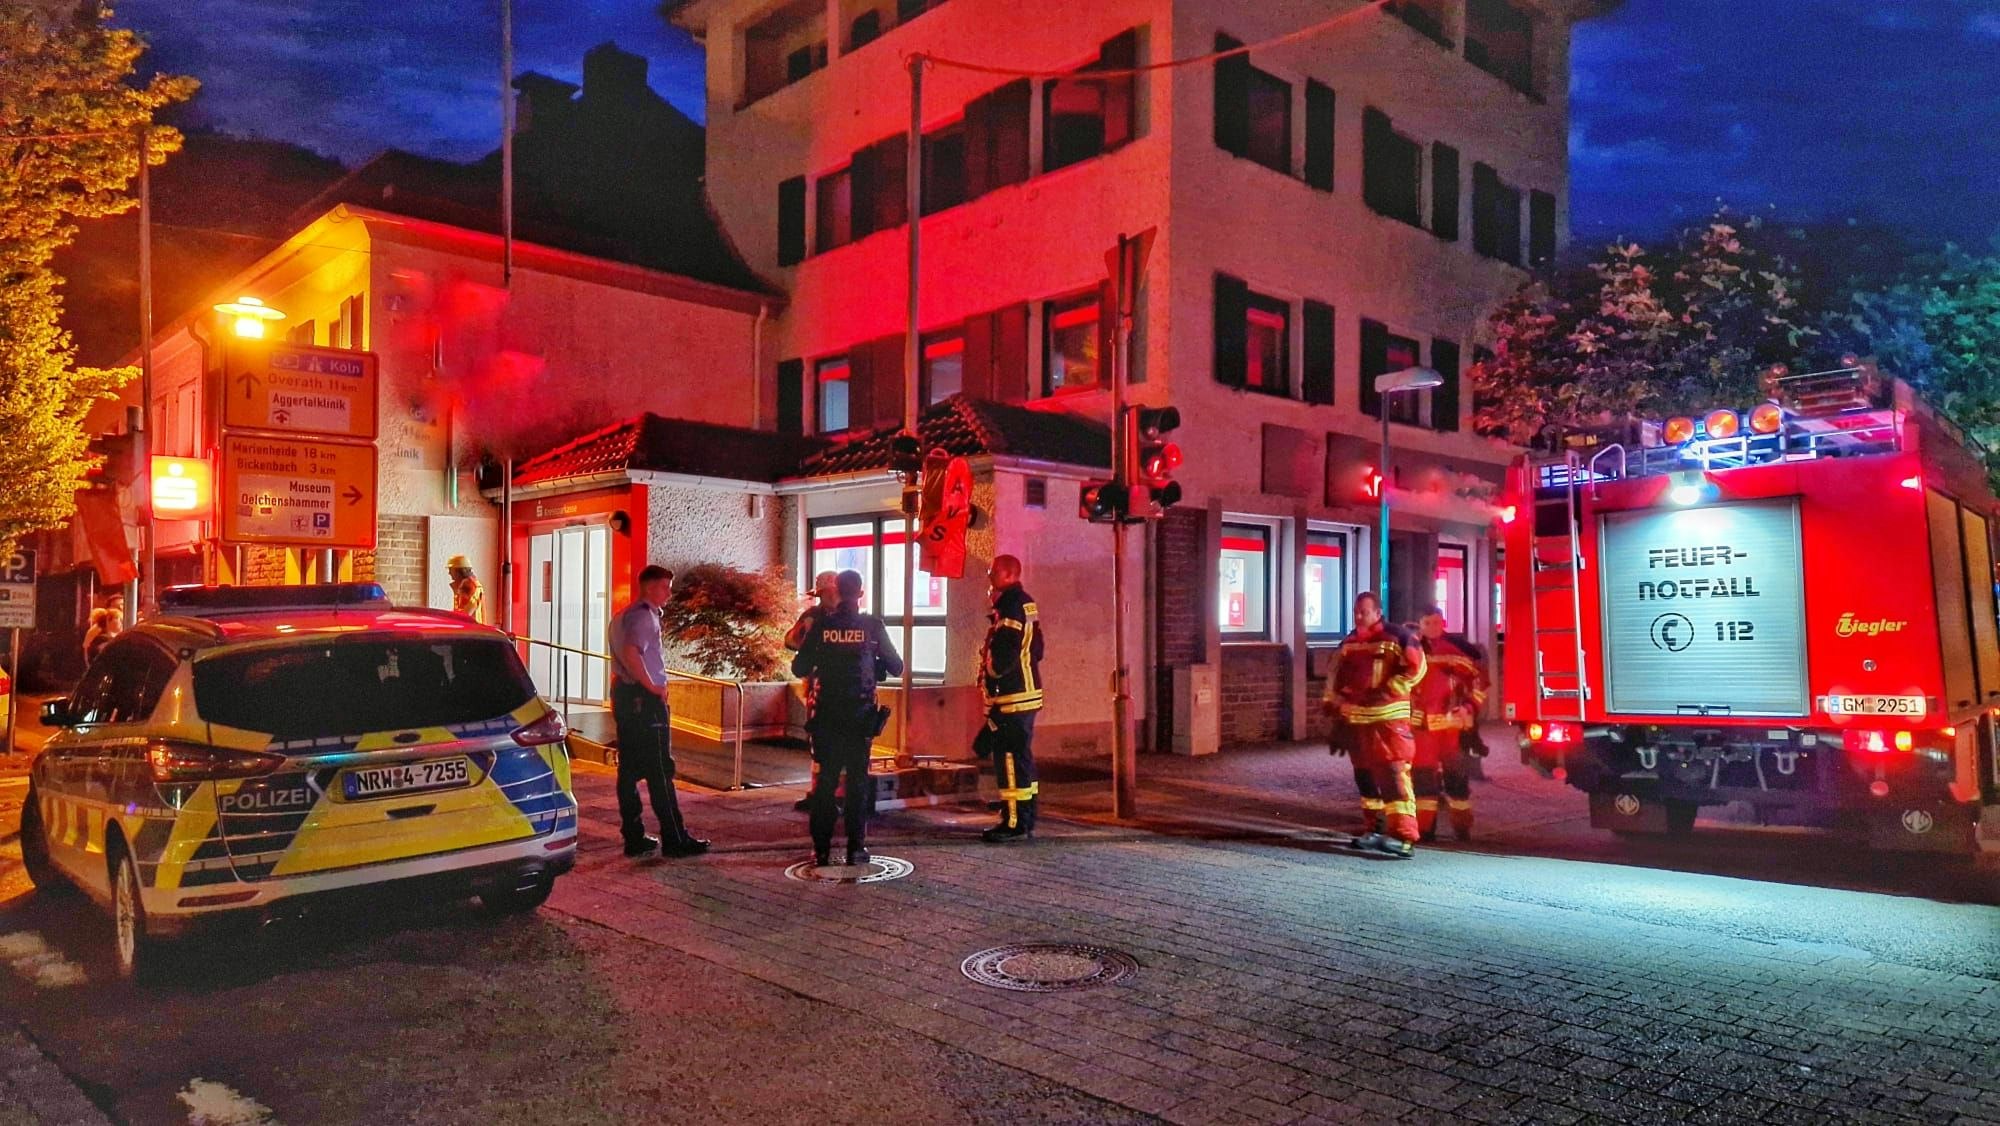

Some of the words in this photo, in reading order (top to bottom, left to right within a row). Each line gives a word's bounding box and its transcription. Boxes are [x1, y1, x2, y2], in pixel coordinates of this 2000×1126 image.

[268, 373, 323, 388] Overath
[329, 379, 339, 391] 11
[342, 382, 359, 392] km
[272, 392, 346, 410] Aggertalklinik
[233, 441, 297, 457] Marienheide
[304, 447, 317, 459] 18
[320, 451, 336, 460] km
[237, 458, 297, 472] Bickenbach
[309, 463, 317, 474] 3
[320, 466, 336, 475] km
[289, 481, 331, 494] Museum
[241, 493, 330, 509] Oelchenshammer
[317, 514, 327, 526] P
[1649, 545, 1747, 568] FEUER-
[1638, 576, 1760, 601] NOTFALL
[1715, 621, 1754, 641] 112
[1836, 612, 1907, 637] Ziegler
[823, 629, 865, 643] POLIZEI
[1843, 697, 1865, 713] GM
[1877, 698, 1920, 713] 2951
[356, 770, 393, 792] NRW
[403, 760, 467, 785] 4-7255
[222, 787, 311, 812] POLIZEI
